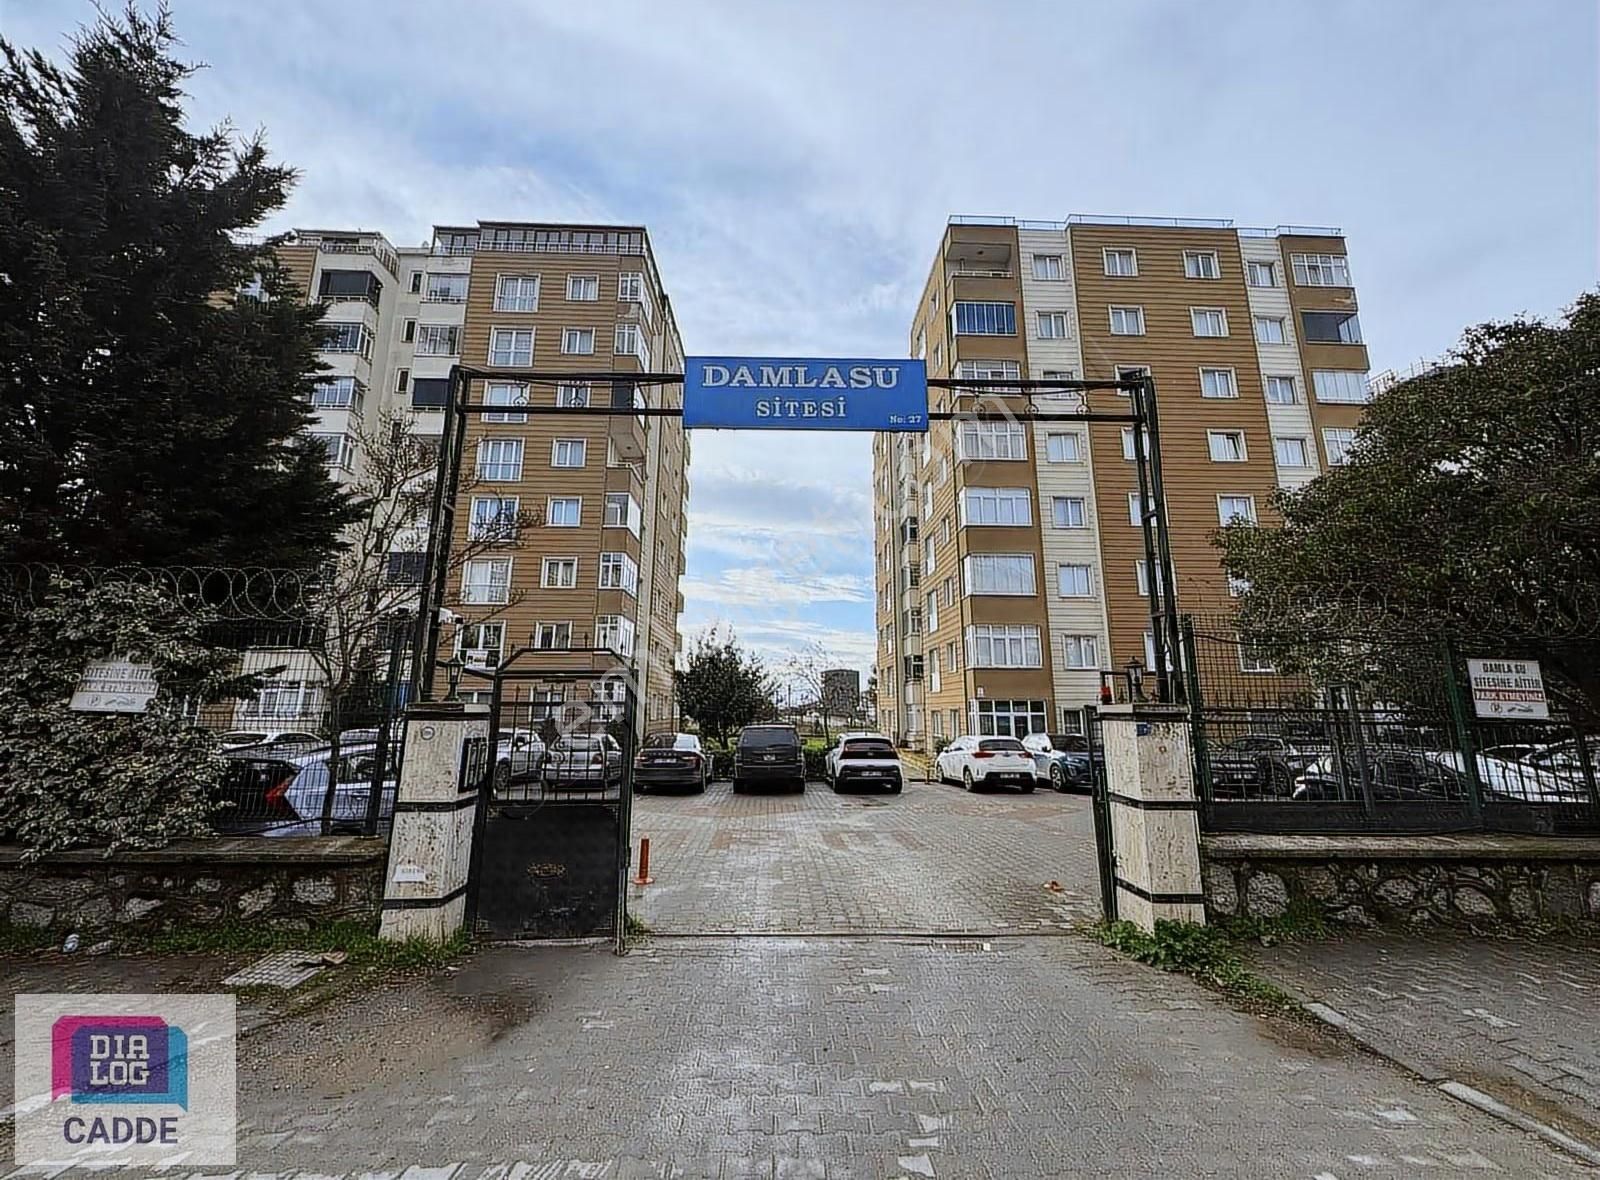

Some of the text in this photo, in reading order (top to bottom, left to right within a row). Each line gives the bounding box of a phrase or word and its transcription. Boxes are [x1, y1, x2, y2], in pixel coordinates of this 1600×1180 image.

[702, 365, 900, 389] DAMLASU
[756, 397, 846, 417] SİTESİ
[907, 415, 922, 424] 27
